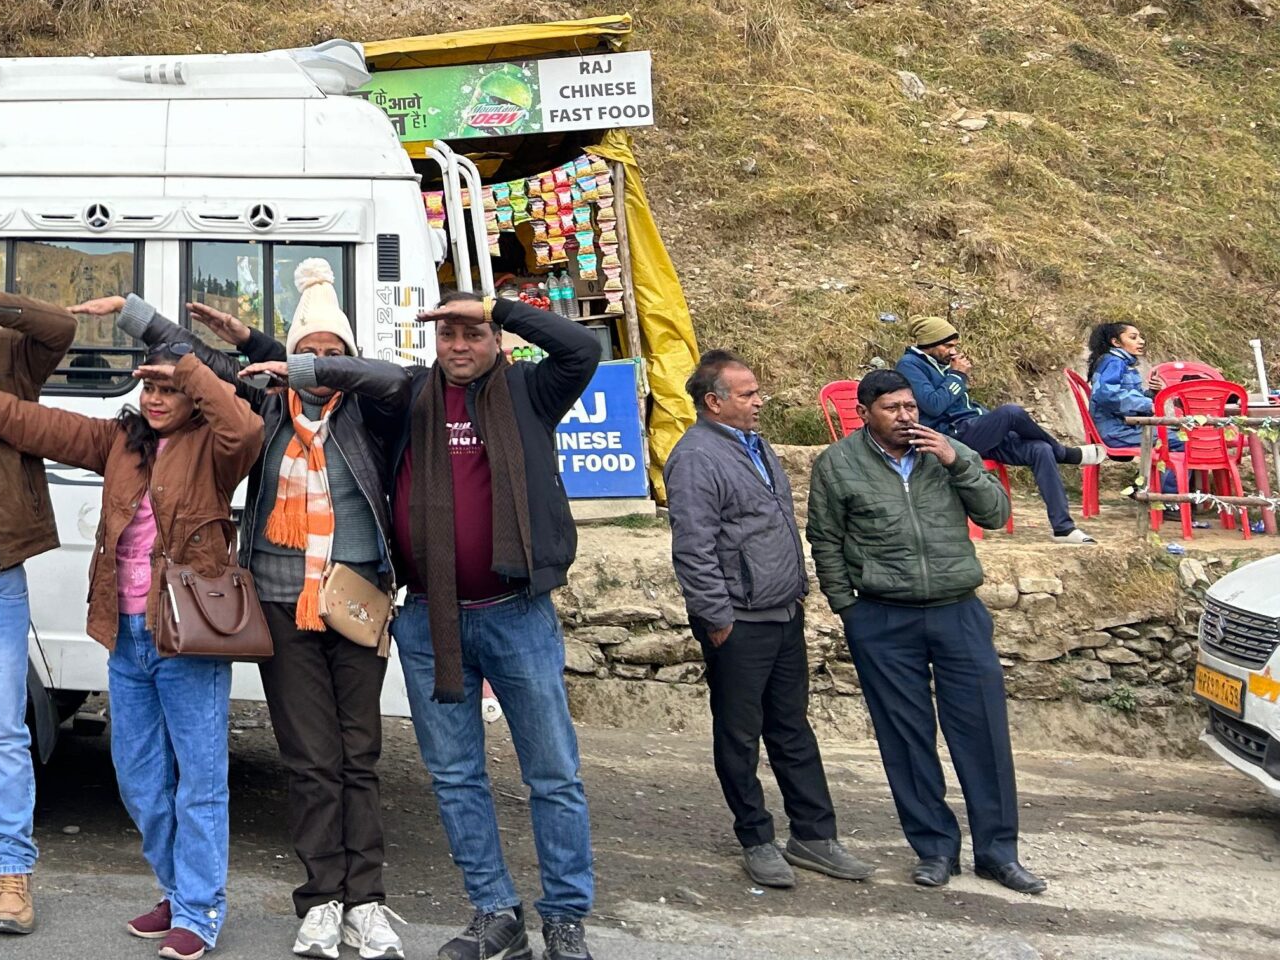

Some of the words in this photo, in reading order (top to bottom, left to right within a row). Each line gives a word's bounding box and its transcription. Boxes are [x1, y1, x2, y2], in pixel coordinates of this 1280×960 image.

[579, 60, 612, 75] RAJ
[373, 88, 387, 106] के
[388, 92, 423, 110] आगे
[559, 82, 637, 99] CHINESE
[549, 107, 593, 123] FAST
[598, 104, 650, 120] FOOD
[560, 391, 607, 425] AJ
[556, 431, 623, 450] INESE
[572, 453, 636, 473] FOOD
